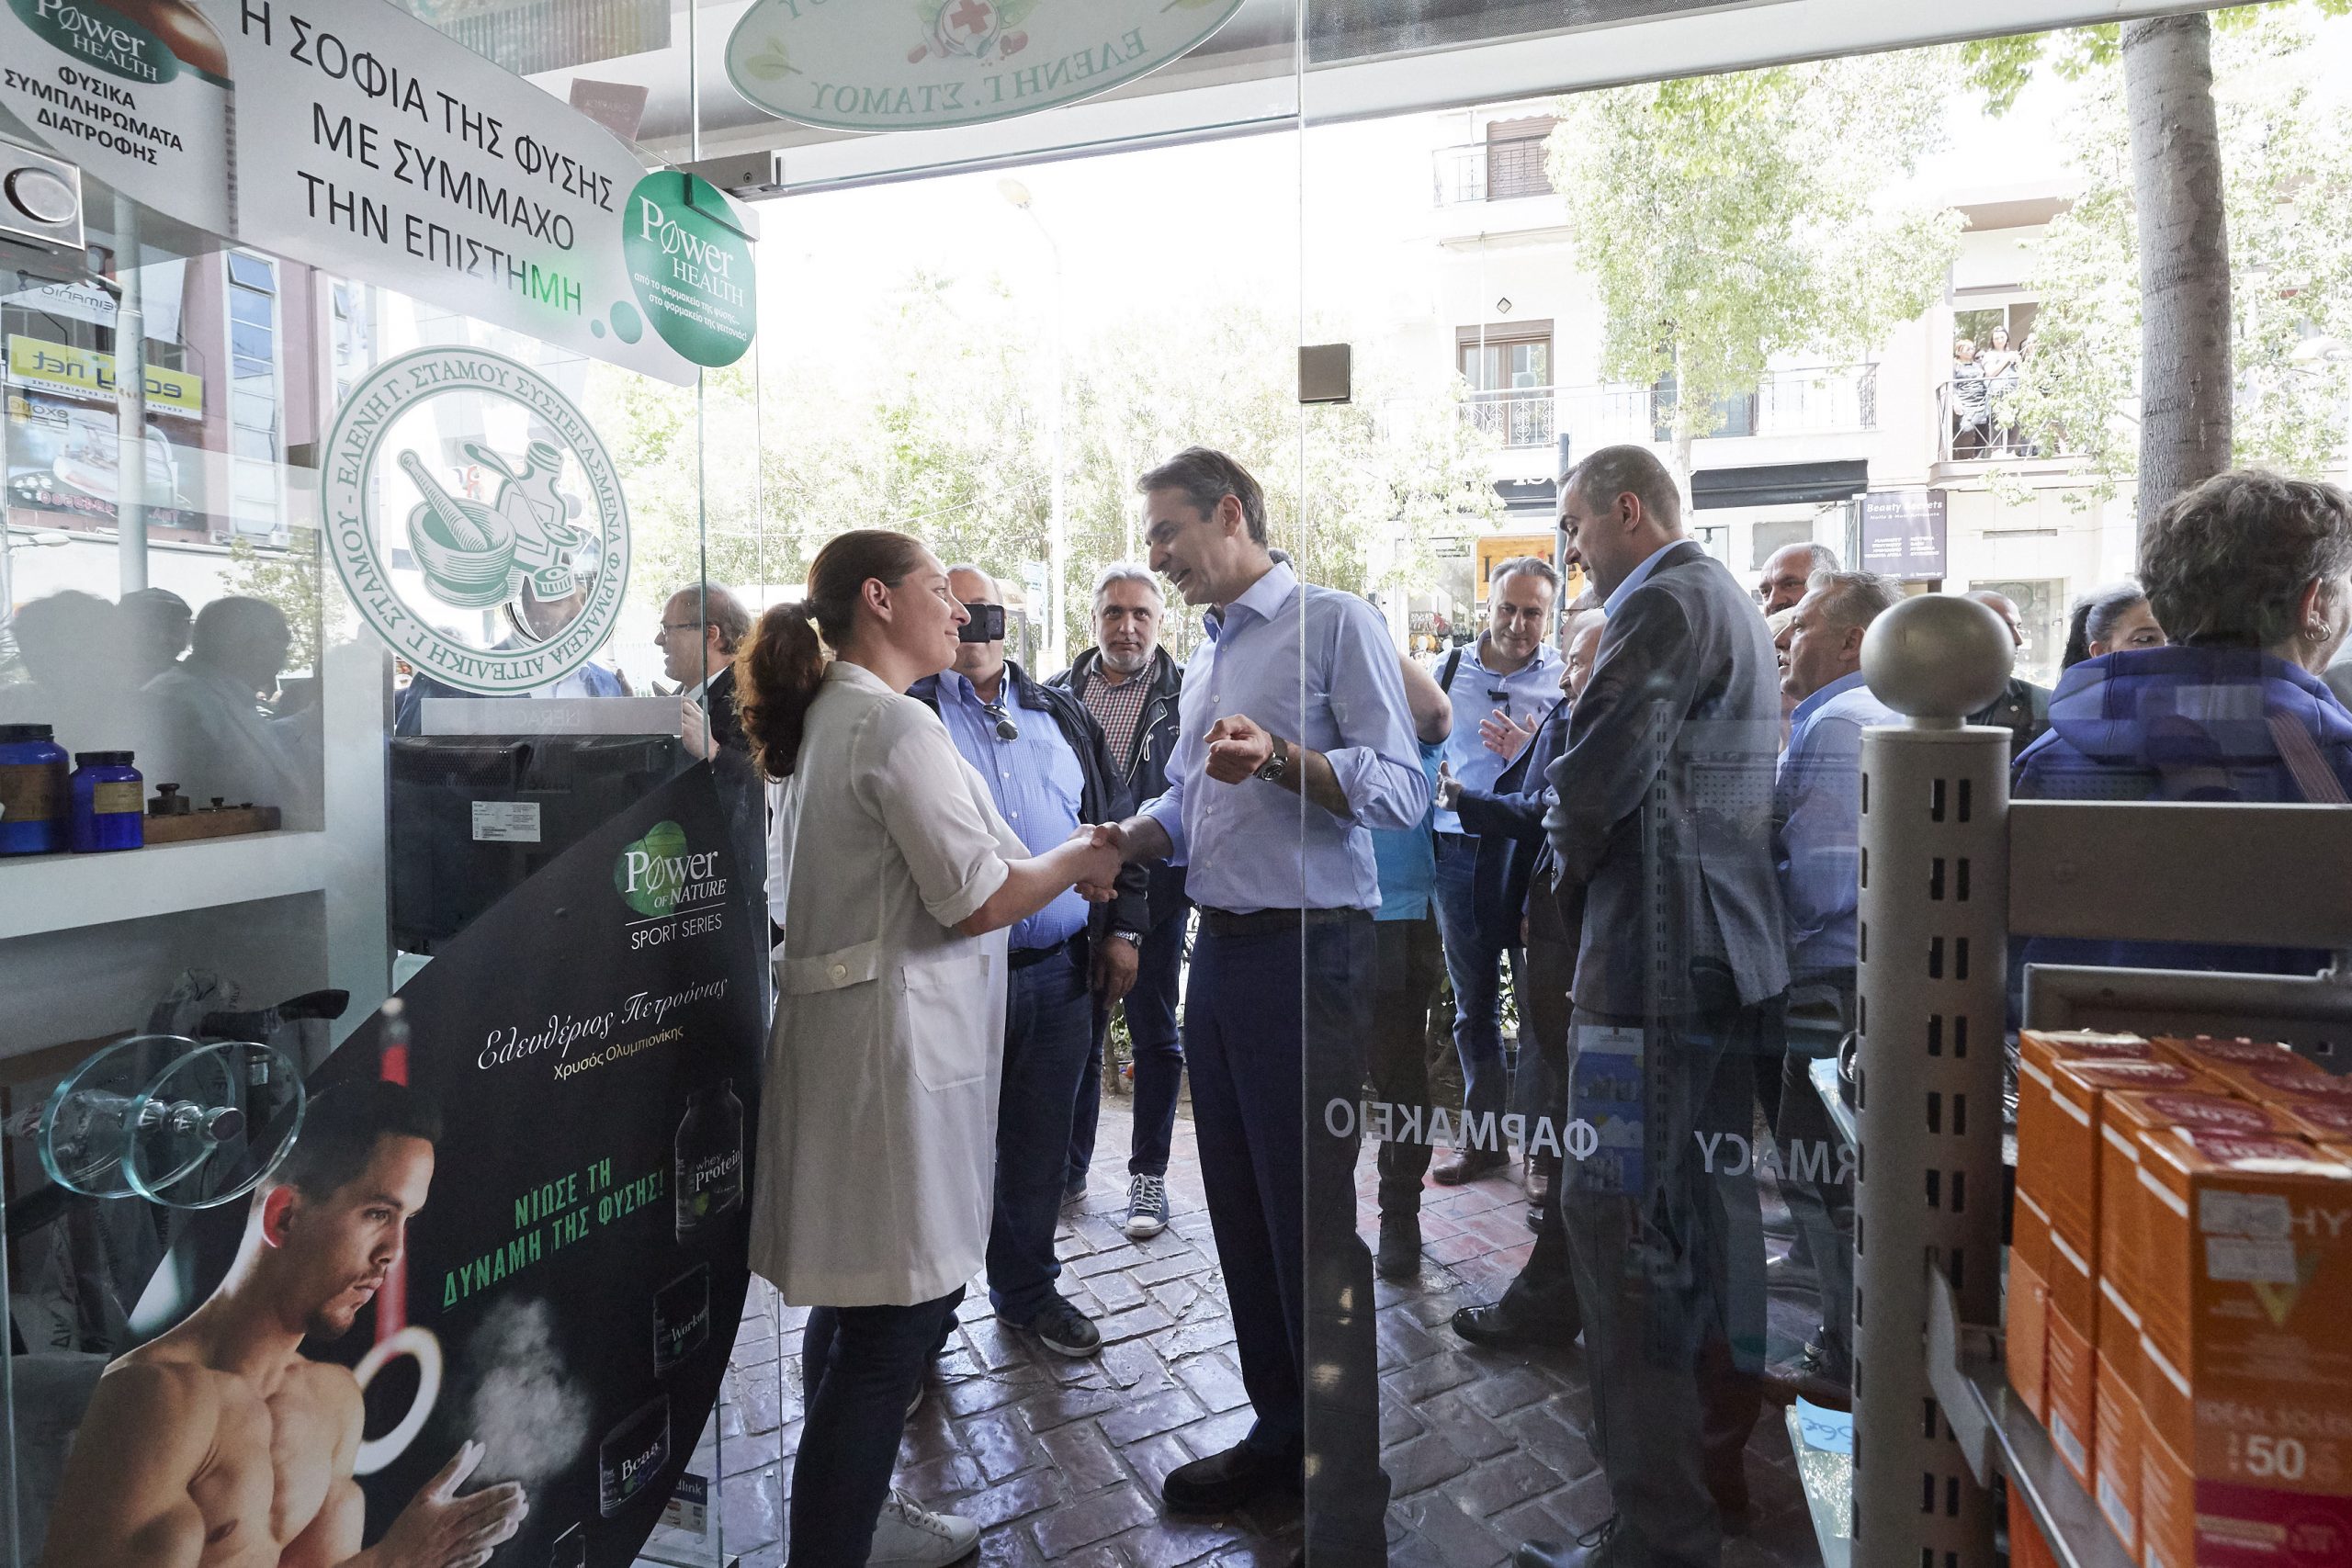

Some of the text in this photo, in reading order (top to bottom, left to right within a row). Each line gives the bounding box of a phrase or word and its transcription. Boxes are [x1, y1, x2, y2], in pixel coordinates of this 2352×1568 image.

[73, 33, 157, 82] HEALTH
[4, 68, 184, 152] ΣΥΜΠΛΗΡΩΜΑΤΑ
[58, 65, 137, 110] ΦΥΣΙΚΑ
[289, 15, 429, 123] ΣΟΦΙΑ
[435, 91, 504, 159] ΤΗΣ
[514, 135, 614, 212] ΦΥΣΗΣ
[37, 107, 158, 165] ΔΙΑΤΡΟΦΗΣ
[313, 102, 574, 251] ΜΕ ΣΥΜΜΑΧΟ
[297, 170, 582, 316] ΤΗΝ ΕΠΙΣΤΗΜΗ
[639, 195, 734, 279] Power
[634, 272, 650, 285] από
[650, 279, 661, 290] το
[661, 283, 701, 309] φαρμακείο
[701, 300, 714, 314] της
[672, 256, 744, 309] HEALTH
[649, 294, 663, 307] στο
[663, 301, 704, 323] φαρμακείο
[704, 314, 717, 329] της
[413, 359, 510, 389] ΣΤΑΜΟΥ
[338, 391, 390, 490] ΕΛΕΝΗ
[514, 378, 621, 545] ΣΥΣΤΕΓΑΣΜΕΝΑ
[1866, 503, 1902, 513] Beauty
[339, 511, 407, 630] ΣΤΑΜΟΥ
[548, 551, 620, 665] ΦΑΡΜΑΚΕΙΑ
[426, 640, 544, 682] ΑΓΓΕΛΙΚΗ
[624, 850, 719, 895] Power
[653, 877, 728, 909] OF NATURE
[630, 912, 723, 952] SPORT SERIES
[477, 976, 729, 1070] Ελευθέριος Πετρούνιας
[553, 1023, 684, 1081] Χρυσός Ολυμπιονίκης
[694, 1148, 741, 1193] Protein
[695, 1152, 723, 1172] whey
[514, 1156, 613, 1231] ΝΙΩΣΕ ΤΗ
[441, 1168, 665, 1310] ΔΥΝΑΜΗ ΤΗΣ ΦΥΣΗΣ!
[620, 1440, 661, 1483] Bcaa
[2245, 1433, 2307, 1482] 50
